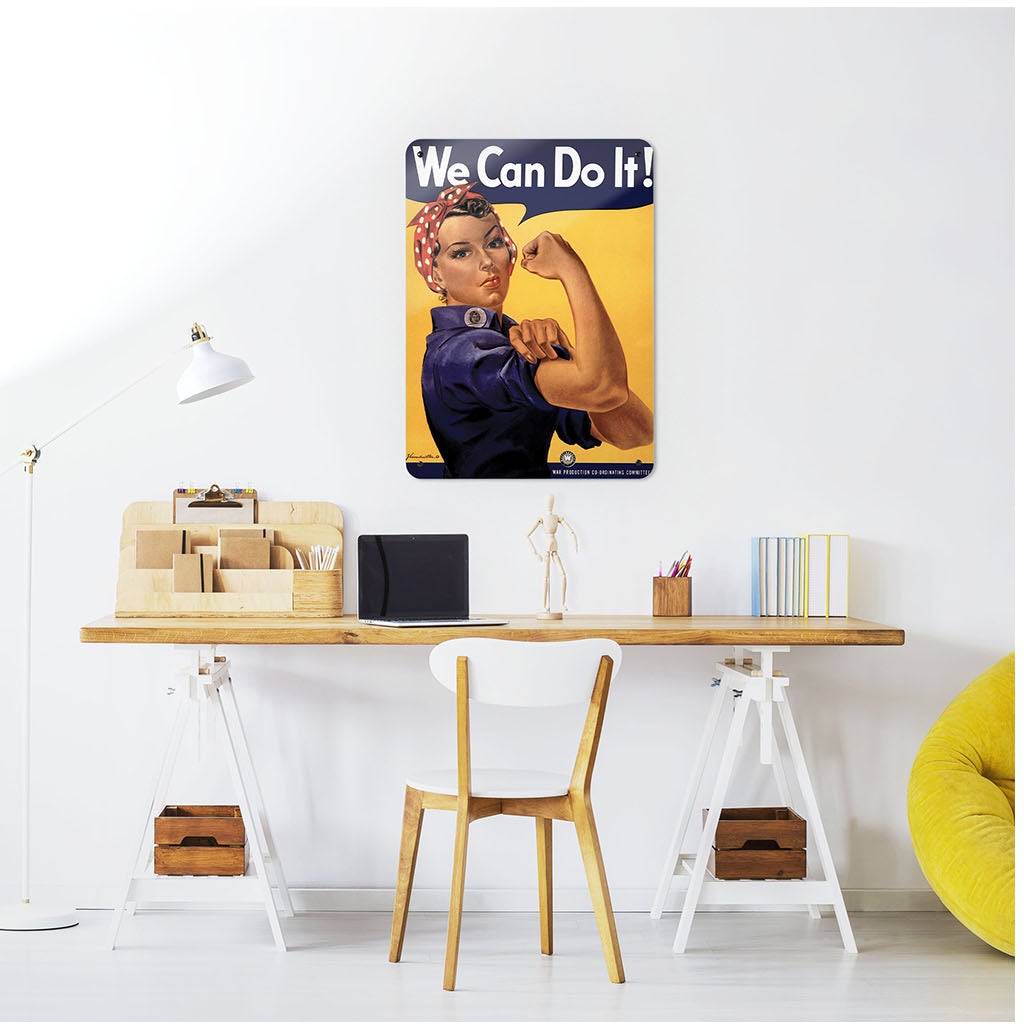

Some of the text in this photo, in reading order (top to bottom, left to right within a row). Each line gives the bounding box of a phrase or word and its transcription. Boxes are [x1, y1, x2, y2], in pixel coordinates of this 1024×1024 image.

[412, 145, 654, 189] We Can Do It!
